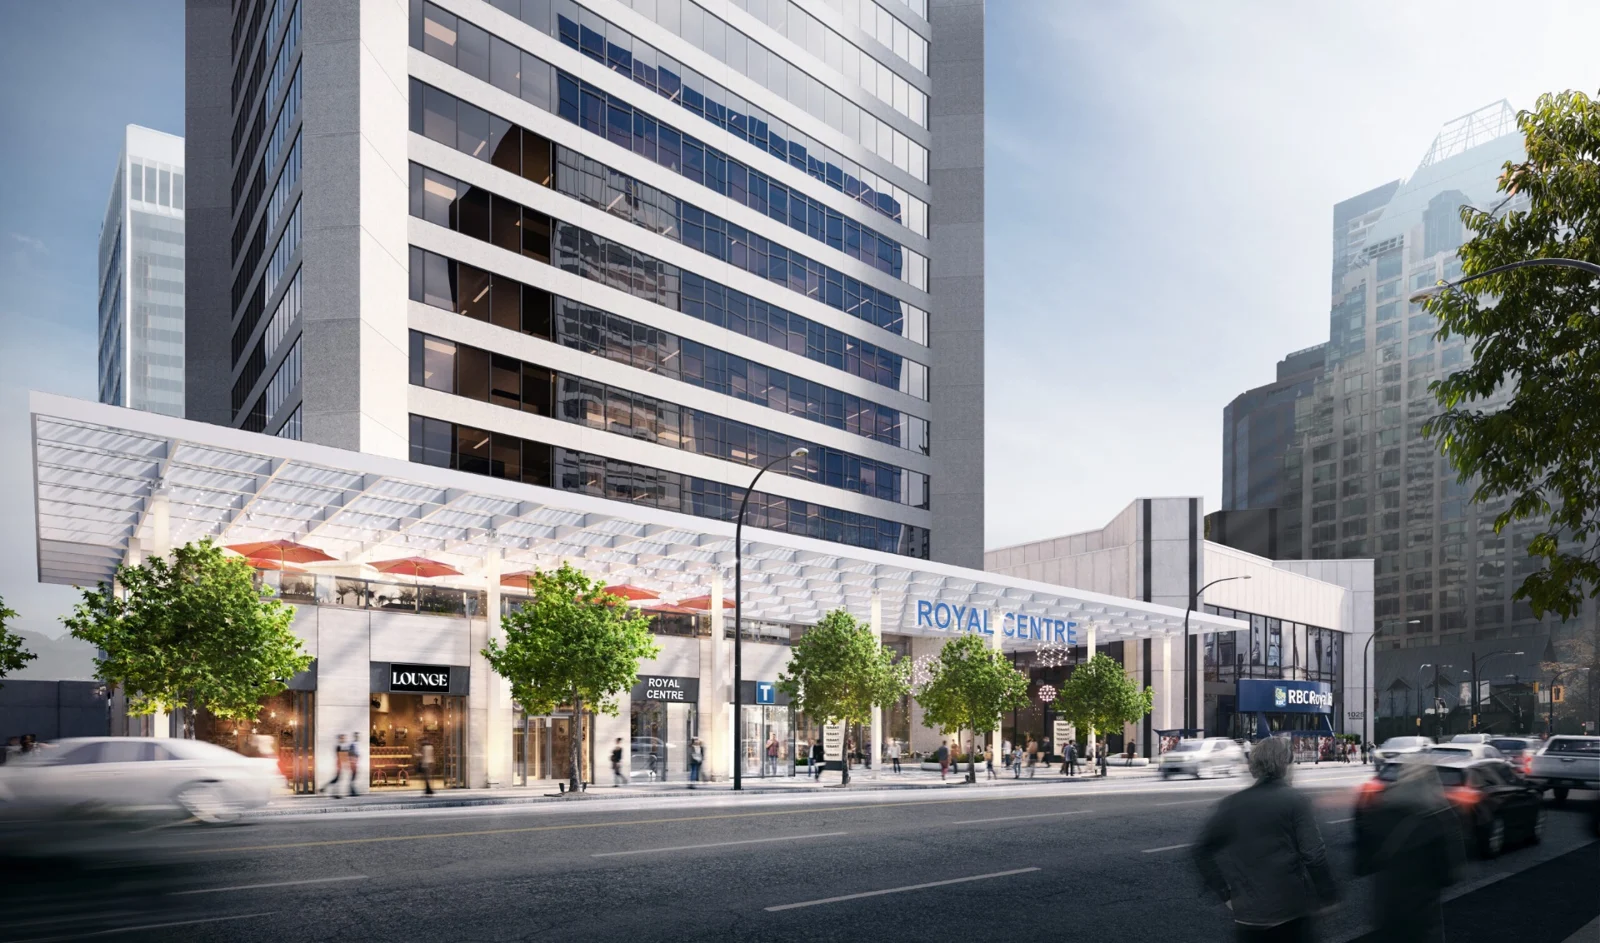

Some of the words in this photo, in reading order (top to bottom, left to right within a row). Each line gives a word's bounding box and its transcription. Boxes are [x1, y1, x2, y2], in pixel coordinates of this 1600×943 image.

[917, 600, 994, 635] ROYAL
[1003, 612, 1077, 645] CENTRE
[392, 671, 448, 687] LOUNGE
[648, 678, 680, 688] ROYAL
[646, 690, 684, 700] CENTRE
[760, 684, 771, 701] T
[1288, 689, 1309, 704] RBC
